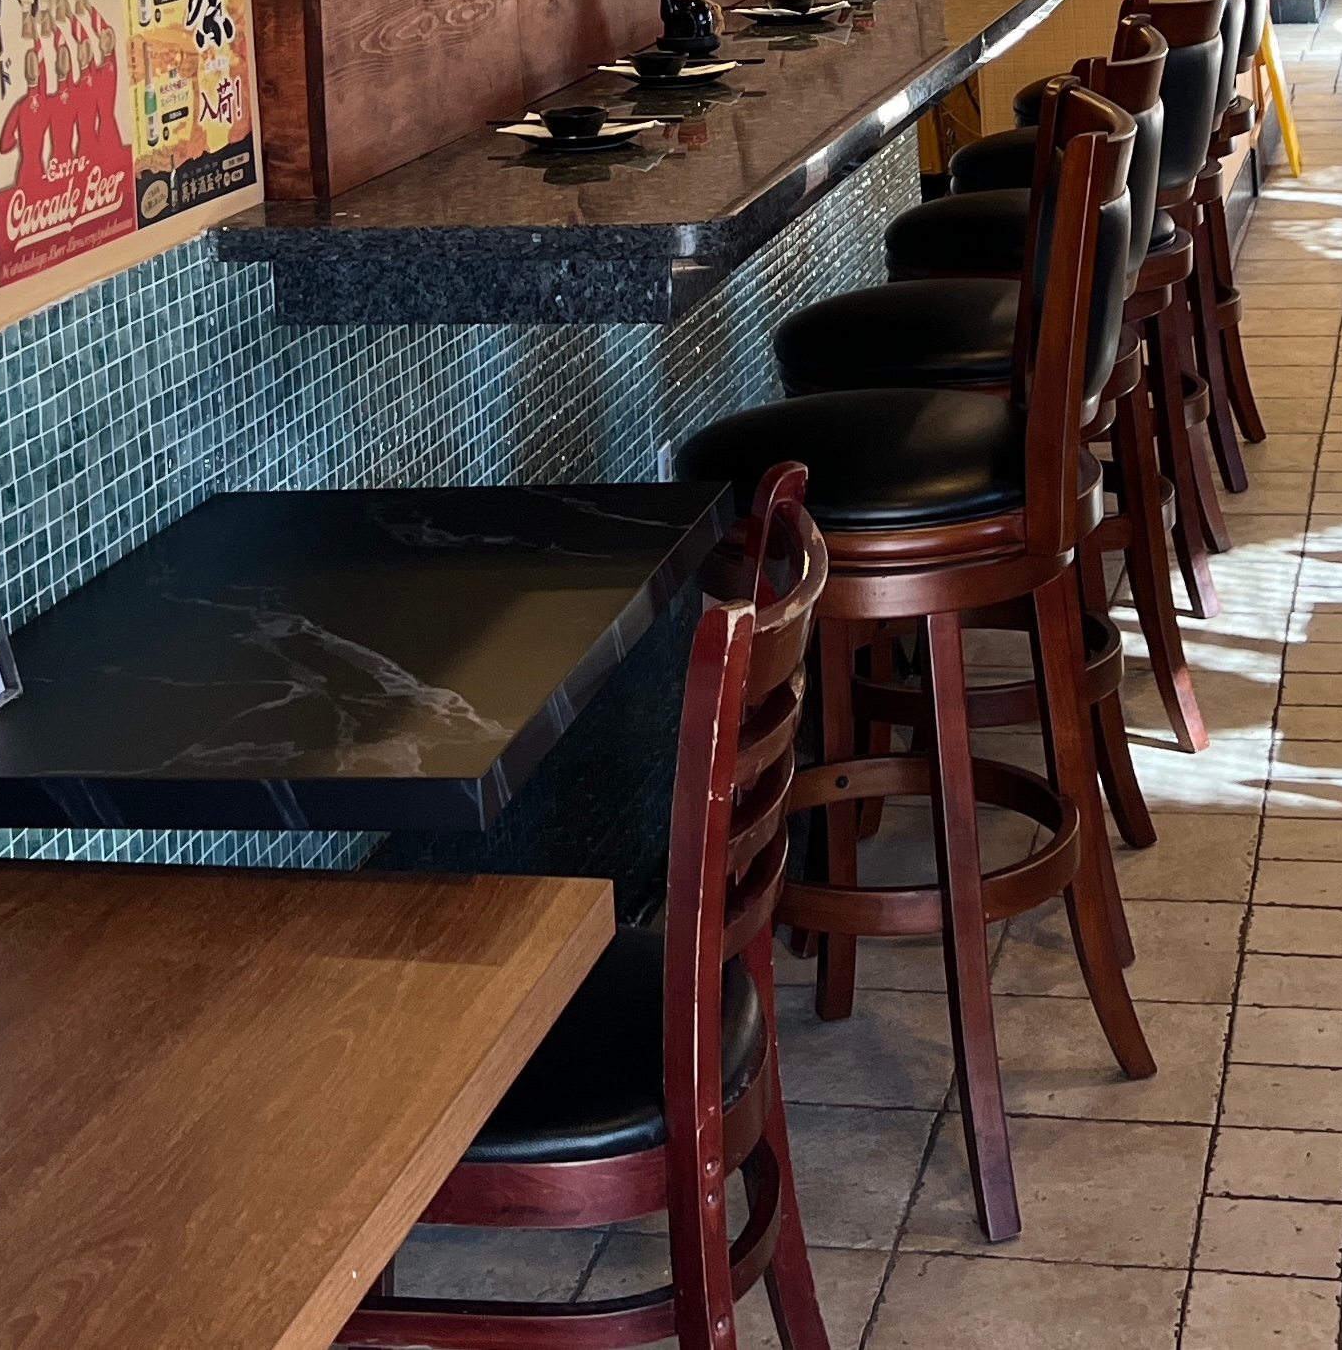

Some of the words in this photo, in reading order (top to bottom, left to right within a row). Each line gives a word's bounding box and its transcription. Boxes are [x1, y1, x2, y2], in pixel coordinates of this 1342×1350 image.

[199, 77, 242, 125] 入荷!
[6, 177, 81, 242] Cascade
[81, 164, 126, 215] Beer
